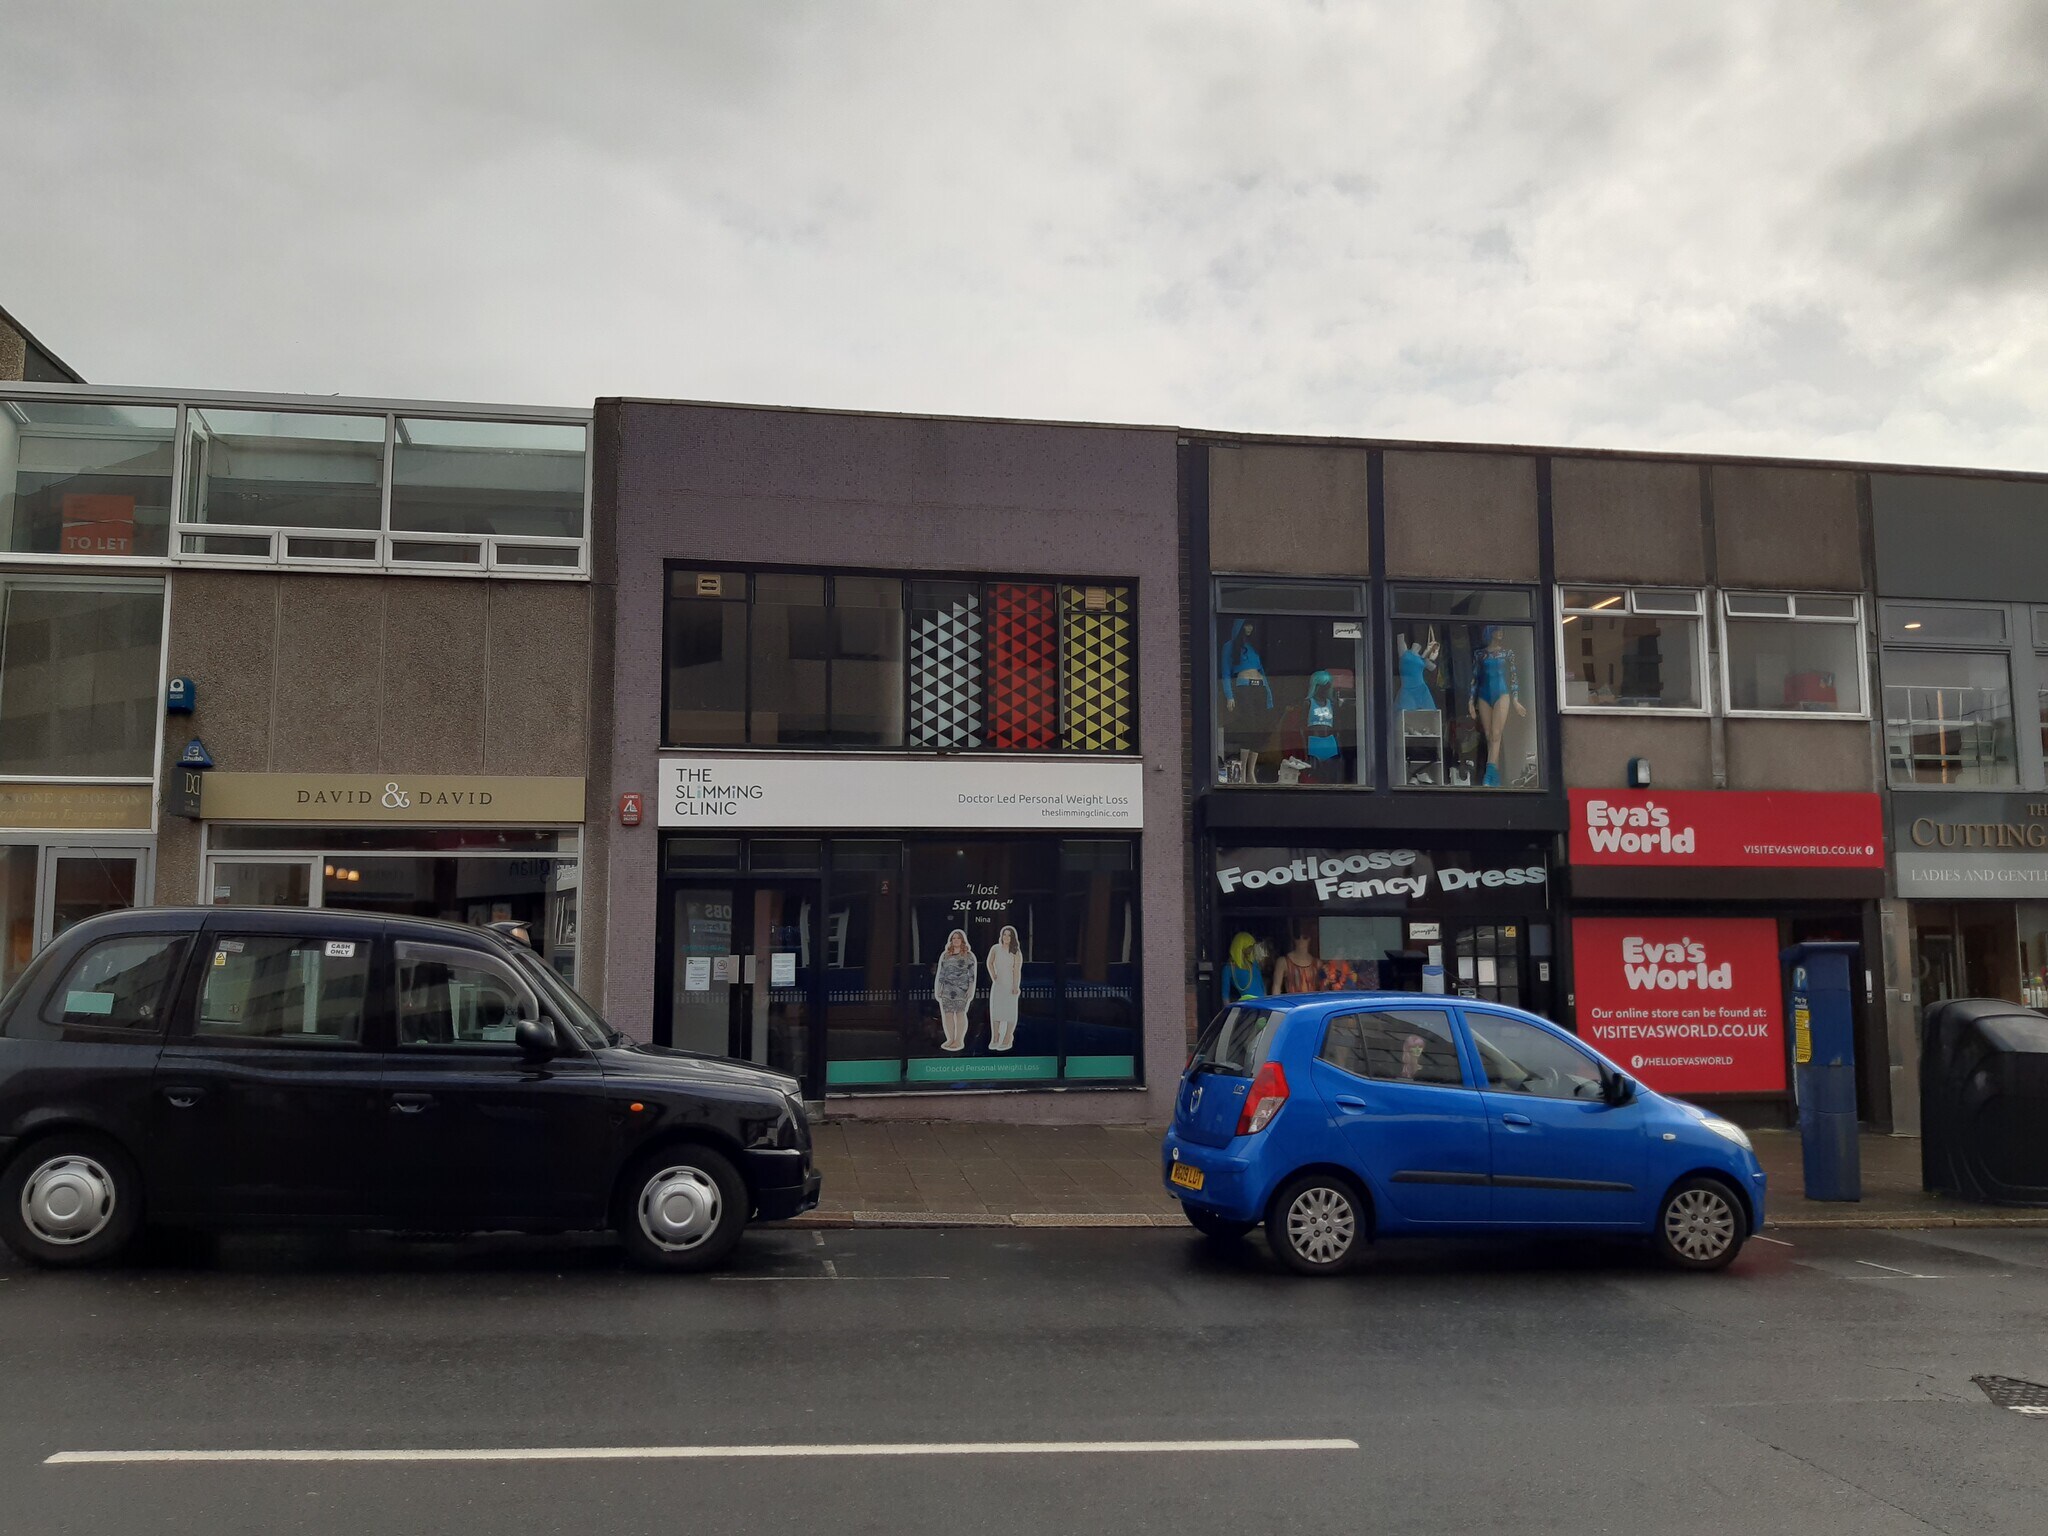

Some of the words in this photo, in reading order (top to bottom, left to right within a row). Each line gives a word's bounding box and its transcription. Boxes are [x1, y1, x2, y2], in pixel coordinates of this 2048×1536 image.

[67, 536, 92, 550] TO
[97, 537, 128, 550] LET
[675, 768, 712, 782] THE
[297, 790, 372, 804] DAVID
[381, 782, 411, 808] &
[419, 791, 493, 805] DAVID
[958, 793, 995, 804] Doctor
[997, 794, 1016, 804] Led
[1019, 794, 1063, 804] Personal
[1066, 794, 1103, 806] Weight
[1106, 795, 1129, 805] Loss
[675, 801, 737, 815] CLINIC
[1041, 809, 1129, 818] theslimmingclinic.com
[2025, 804, 2048, 816] TH
[1911, 817, 2047, 848] CUTTING
[1588, 826, 1696, 854] World
[1743, 845, 1863, 855] VISITEVASWORLD.CO.UK
[1216, 849, 1416, 894] Footloose
[1911, 869, 1960, 881] LADIES
[1965, 869, 1995, 881] AND
[977, 884, 999, 895] lost
[1314, 874, 1428, 901] Fancy
[1437, 866, 1546, 892] Dress
[952, 900, 972, 910] 5st
[975, 915, 991, 923] Nina
[1624, 962, 1732, 990] World
[1796, 967, 1807, 988] P
[1591, 1008, 1614, 1018] Our
[1616, 1008, 1648, 1018] online
[1651, 1009, 1679, 1018] store
[1681, 1009, 1700, 1018] can
[1703, 1007, 1716, 1018] be
[1719, 1007, 1750, 1018] found
[1752, 1008, 1767, 1018] at:
[1592, 1025, 1768, 1039] VISITEVASWORLD.CO.UK
[925, 1065, 950, 1073] Doctor
[951, 1065, 965, 1073] Led
[966, 1065, 996, 1073] Personal
[998, 1064, 1021, 1073] Weight
